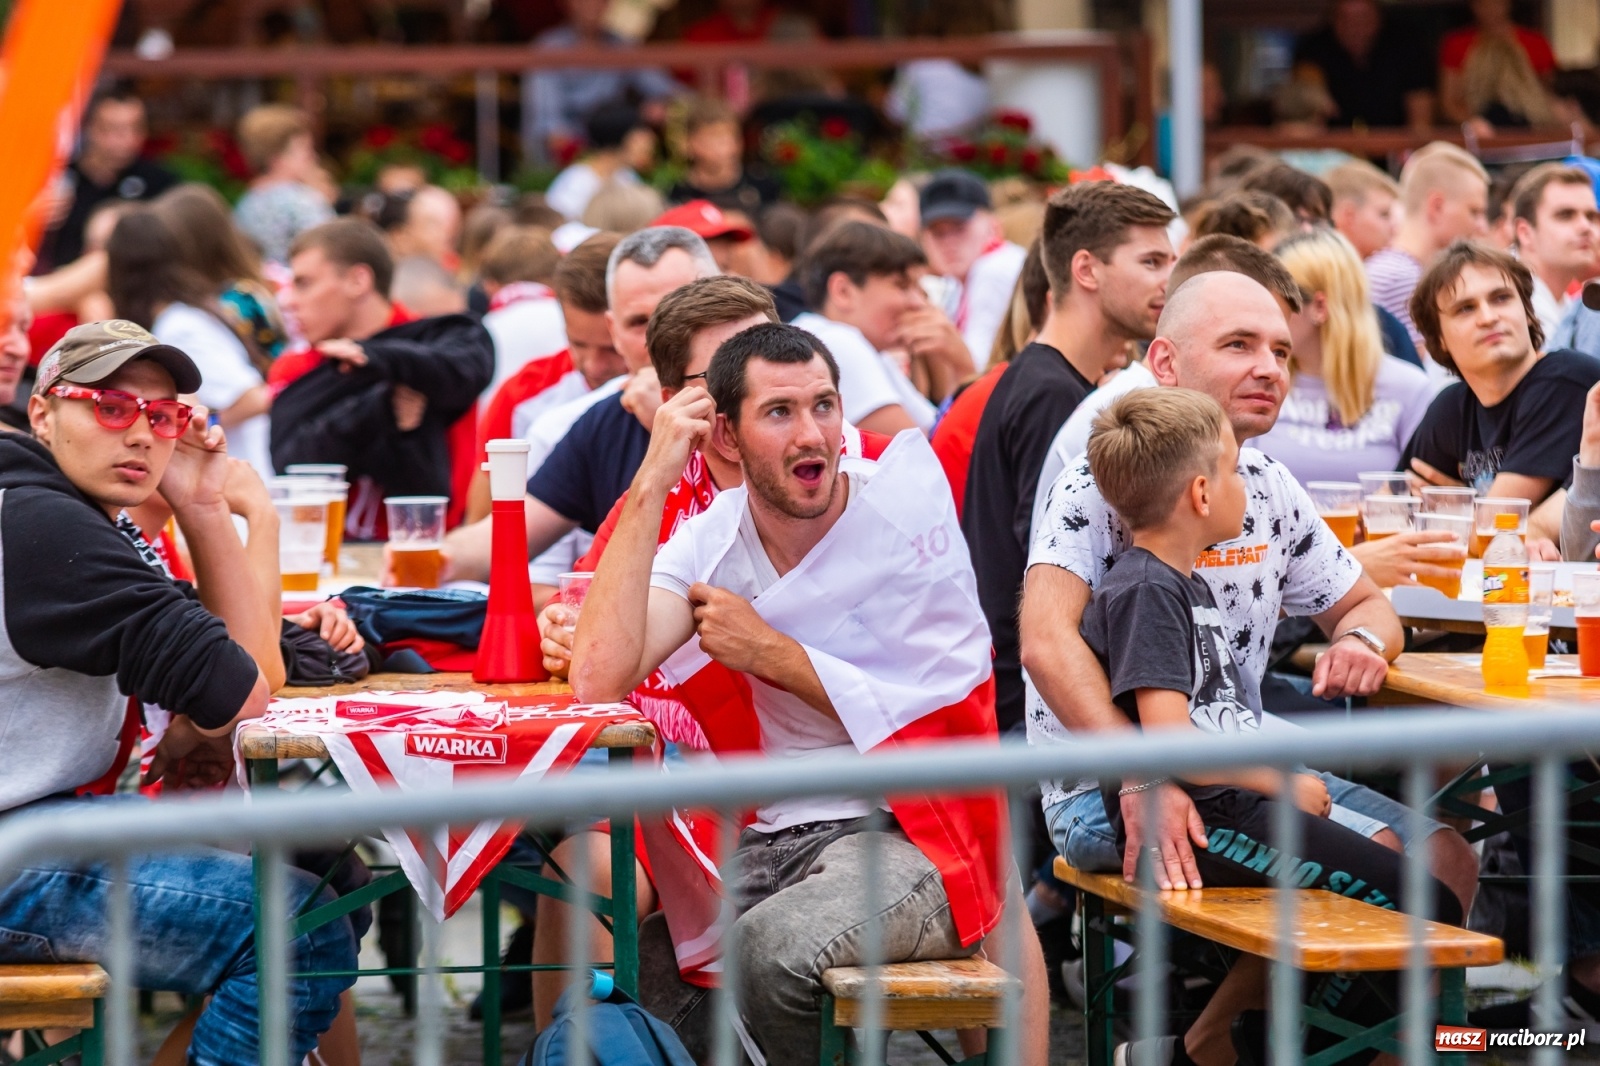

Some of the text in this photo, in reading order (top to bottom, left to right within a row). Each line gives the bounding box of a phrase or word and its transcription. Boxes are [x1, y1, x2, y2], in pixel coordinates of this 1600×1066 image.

[349, 706, 375, 714] WARKA
[413, 735, 497, 757] WARKA
[1204, 826, 1323, 889] UNKNO
